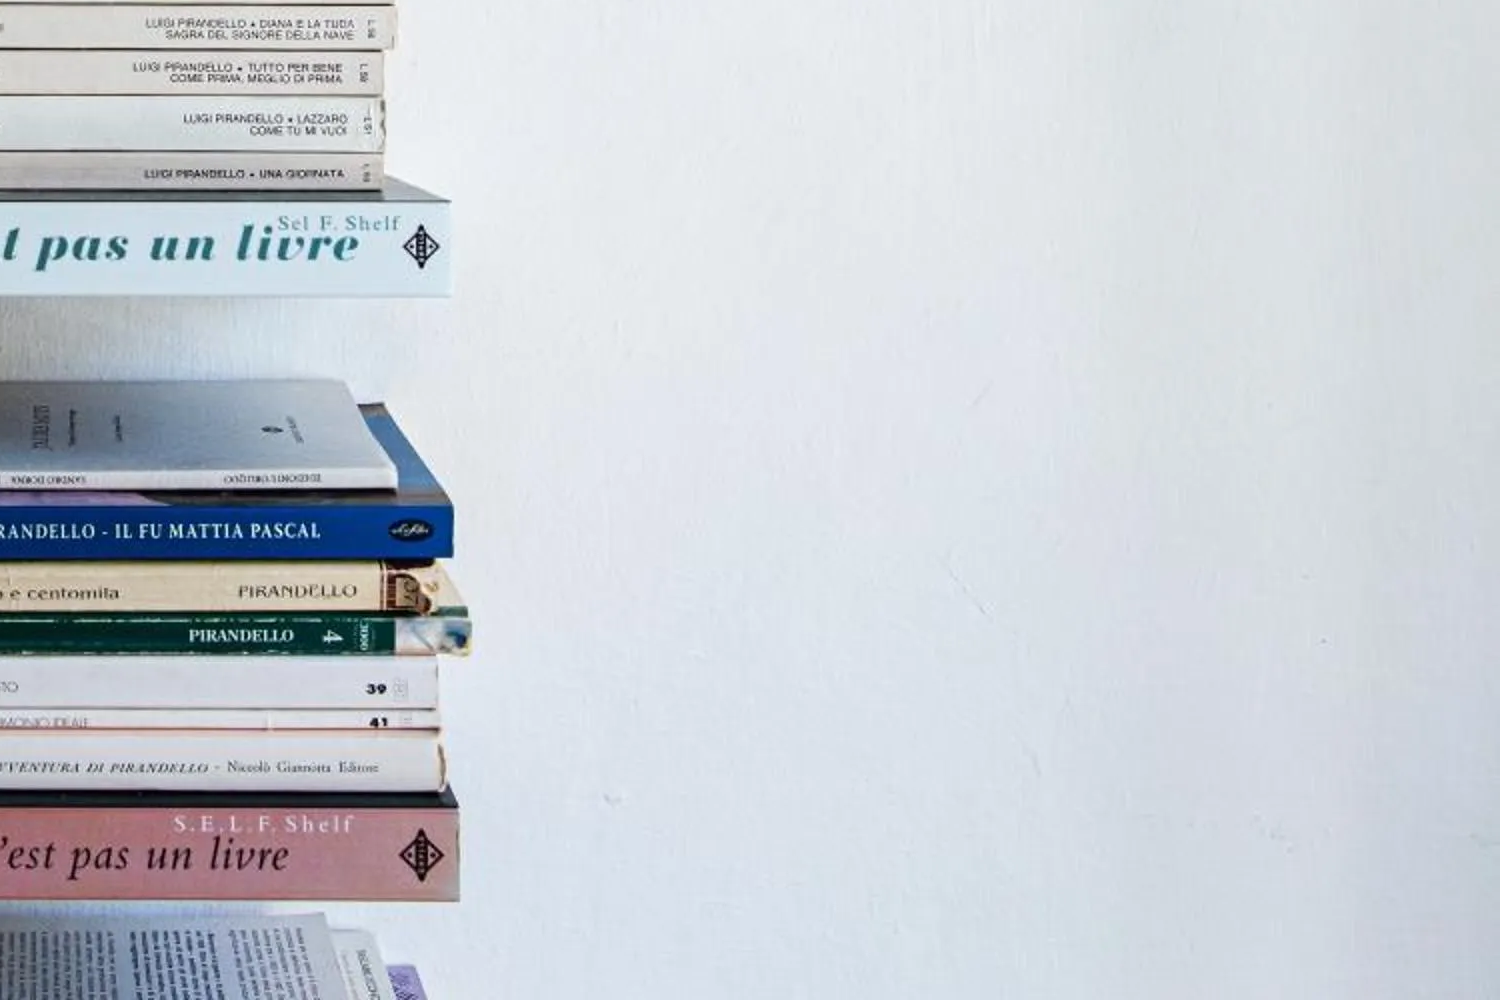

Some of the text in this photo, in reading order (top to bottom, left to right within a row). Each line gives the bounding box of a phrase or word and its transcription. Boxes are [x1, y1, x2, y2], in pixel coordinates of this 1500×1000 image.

[145, 18, 175, 29] LUIGI
[177, 18, 247, 29] PIRANDELLO
[133, 62, 161, 73] LUIGI
[164, 62, 233, 73] PIRANDELLO
[183, 113, 213, 124] LUIGI
[216, 113, 283, 124] PIRANDELLO
[144, 169, 173, 179] LUIGI
[175, 169, 245, 179] PIRANDELLO
[277, 215, 401, 231] Sel F. Shelf
[34, 234, 129, 272] pas
[149, 235, 215, 261] un
[236, 223, 359, 261] livre
[115, 523, 133, 539] IL
[139, 523, 163, 539] FU
[169, 523, 241, 539] MATTIA
[251, 523, 321, 539] PASCAL
[10, 590, 21, 599] e
[27, 588, 119, 600] centomila
[238, 584, 357, 599] PIRANDELLO
[189, 629, 294, 643] PIRANDELLO
[366, 684, 387, 695] 39
[369, 717, 388, 728] 41
[110, 762, 209, 773] PIRANDELLO
[285, 815, 354, 834] Shelf
[67, 847, 129, 881] pas
[147, 849, 193, 870] un
[210, 835, 290, 870] livre
